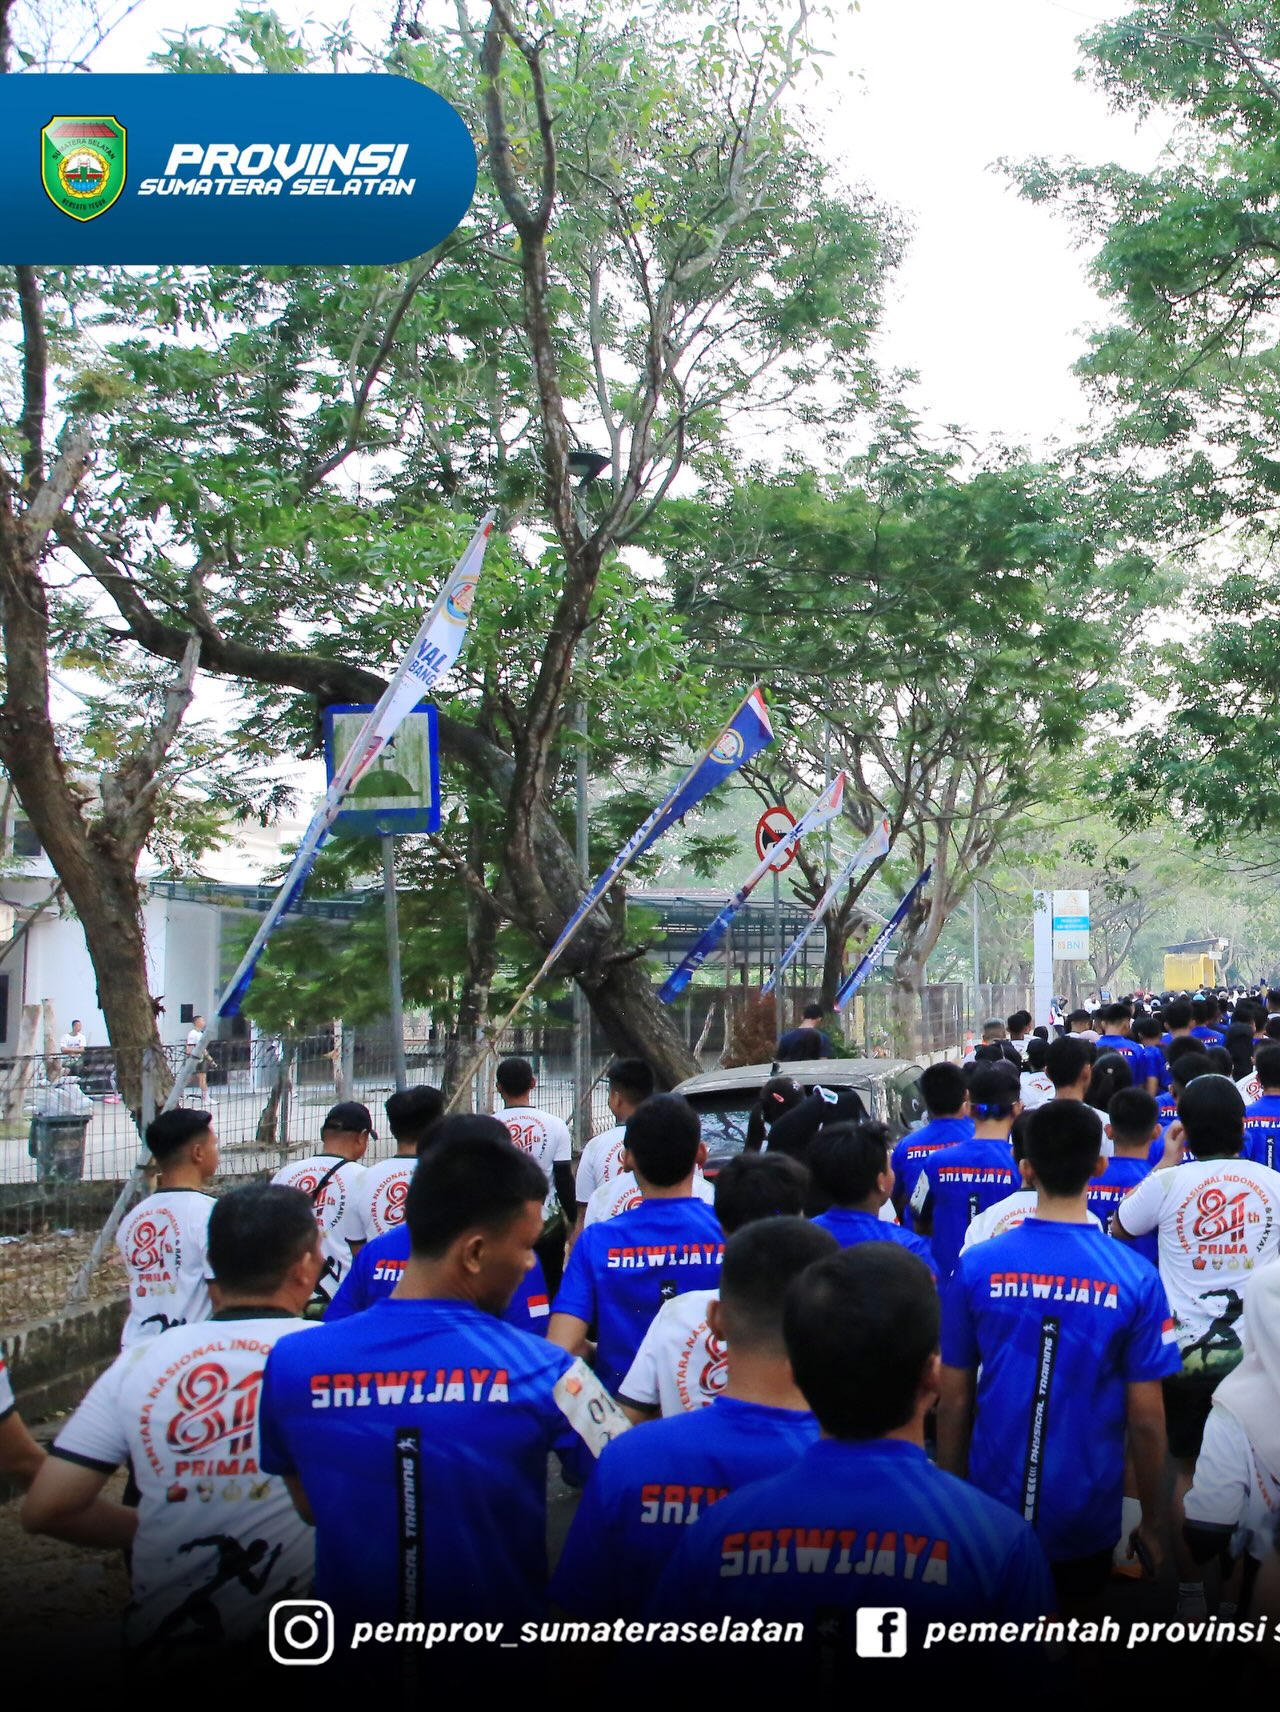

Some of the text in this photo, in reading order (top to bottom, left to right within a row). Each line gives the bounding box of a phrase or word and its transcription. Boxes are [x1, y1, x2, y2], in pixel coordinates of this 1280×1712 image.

[1223, 1174, 1269, 1205] INDONESIA
[1256, 1216, 1273, 1253] RAKYAT
[1198, 1243, 1248, 1254] PRIMA
[990, 1272, 1119, 1310] SRIWIJAYA
[150, 1340, 225, 1399] NASIONAL
[310, 1368, 510, 1409] SRIWIJAYA
[1030, 1336, 1054, 1464] PHYSICAL TRAINING
[140, 1404, 164, 1478] TENTARA
[175, 1458, 258, 1477] PRIMA
[402, 1457, 416, 1539] TRAINING
[719, 1527, 950, 1587] SRIWIJAYA
